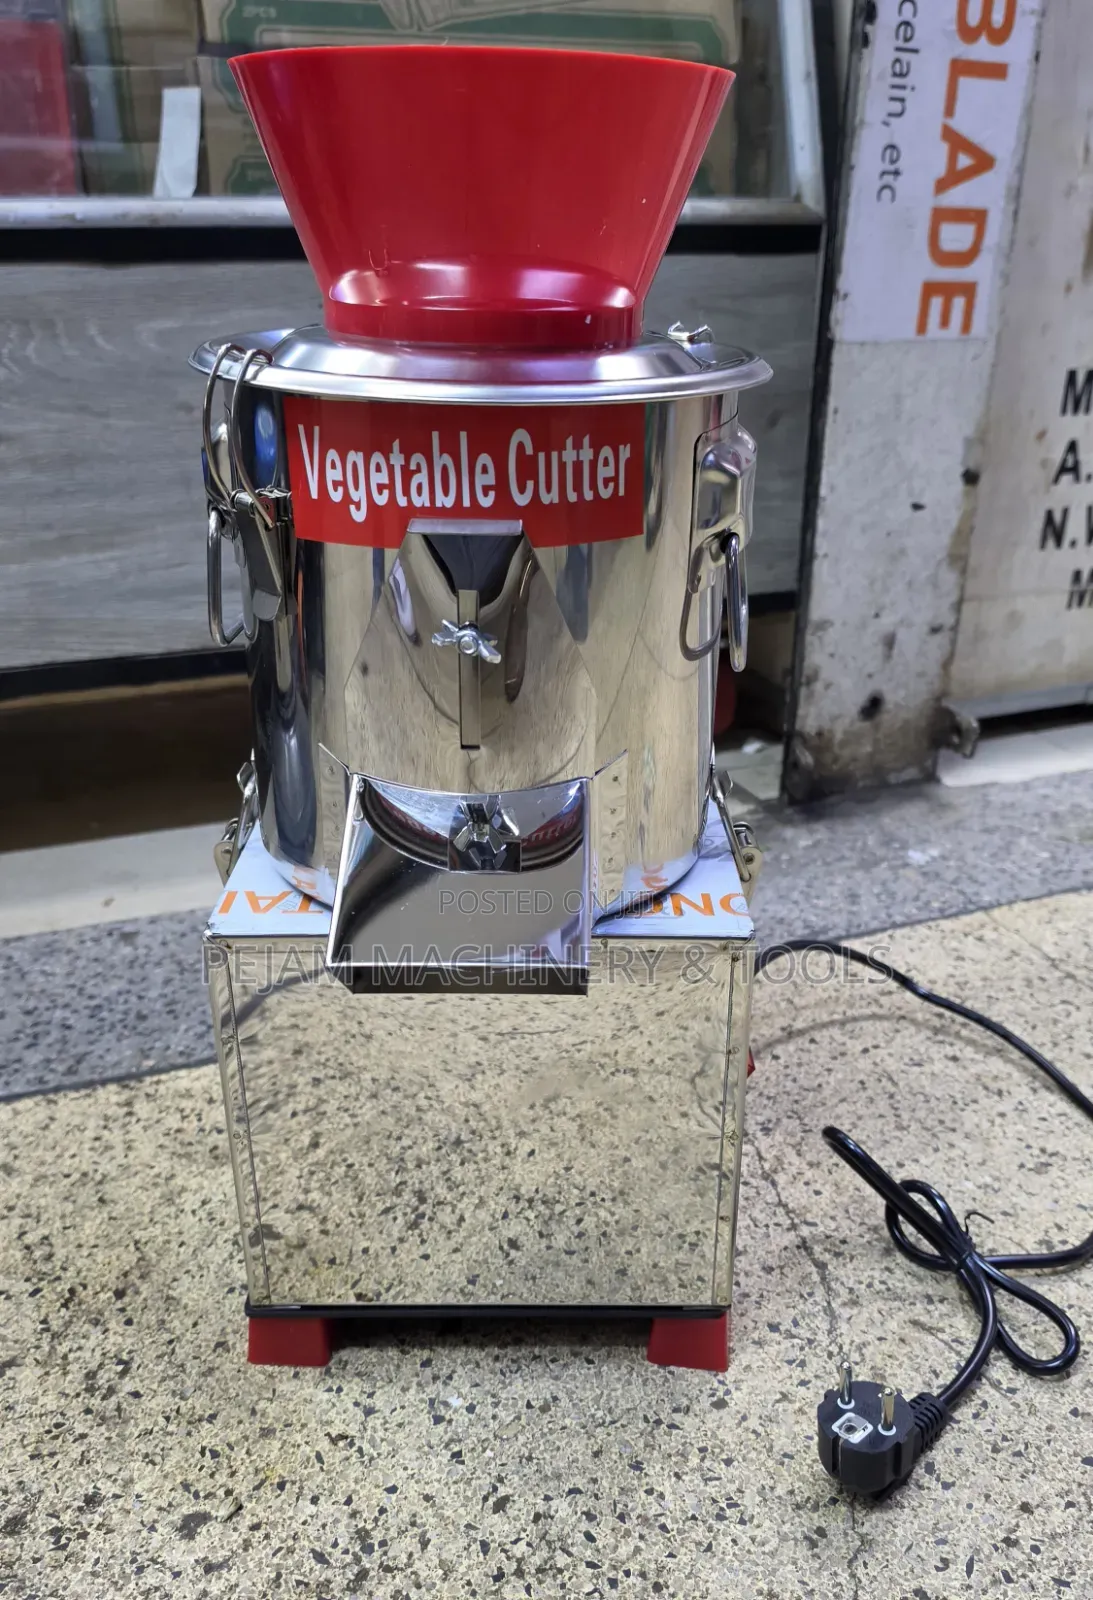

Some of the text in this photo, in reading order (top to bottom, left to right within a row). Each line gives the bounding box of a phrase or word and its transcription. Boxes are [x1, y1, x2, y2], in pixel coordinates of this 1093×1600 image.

[876, 143, 904, 203] etc
[915, 0, 1017, 336] BLADE
[297, 423, 631, 523] Vegetable Cutter
